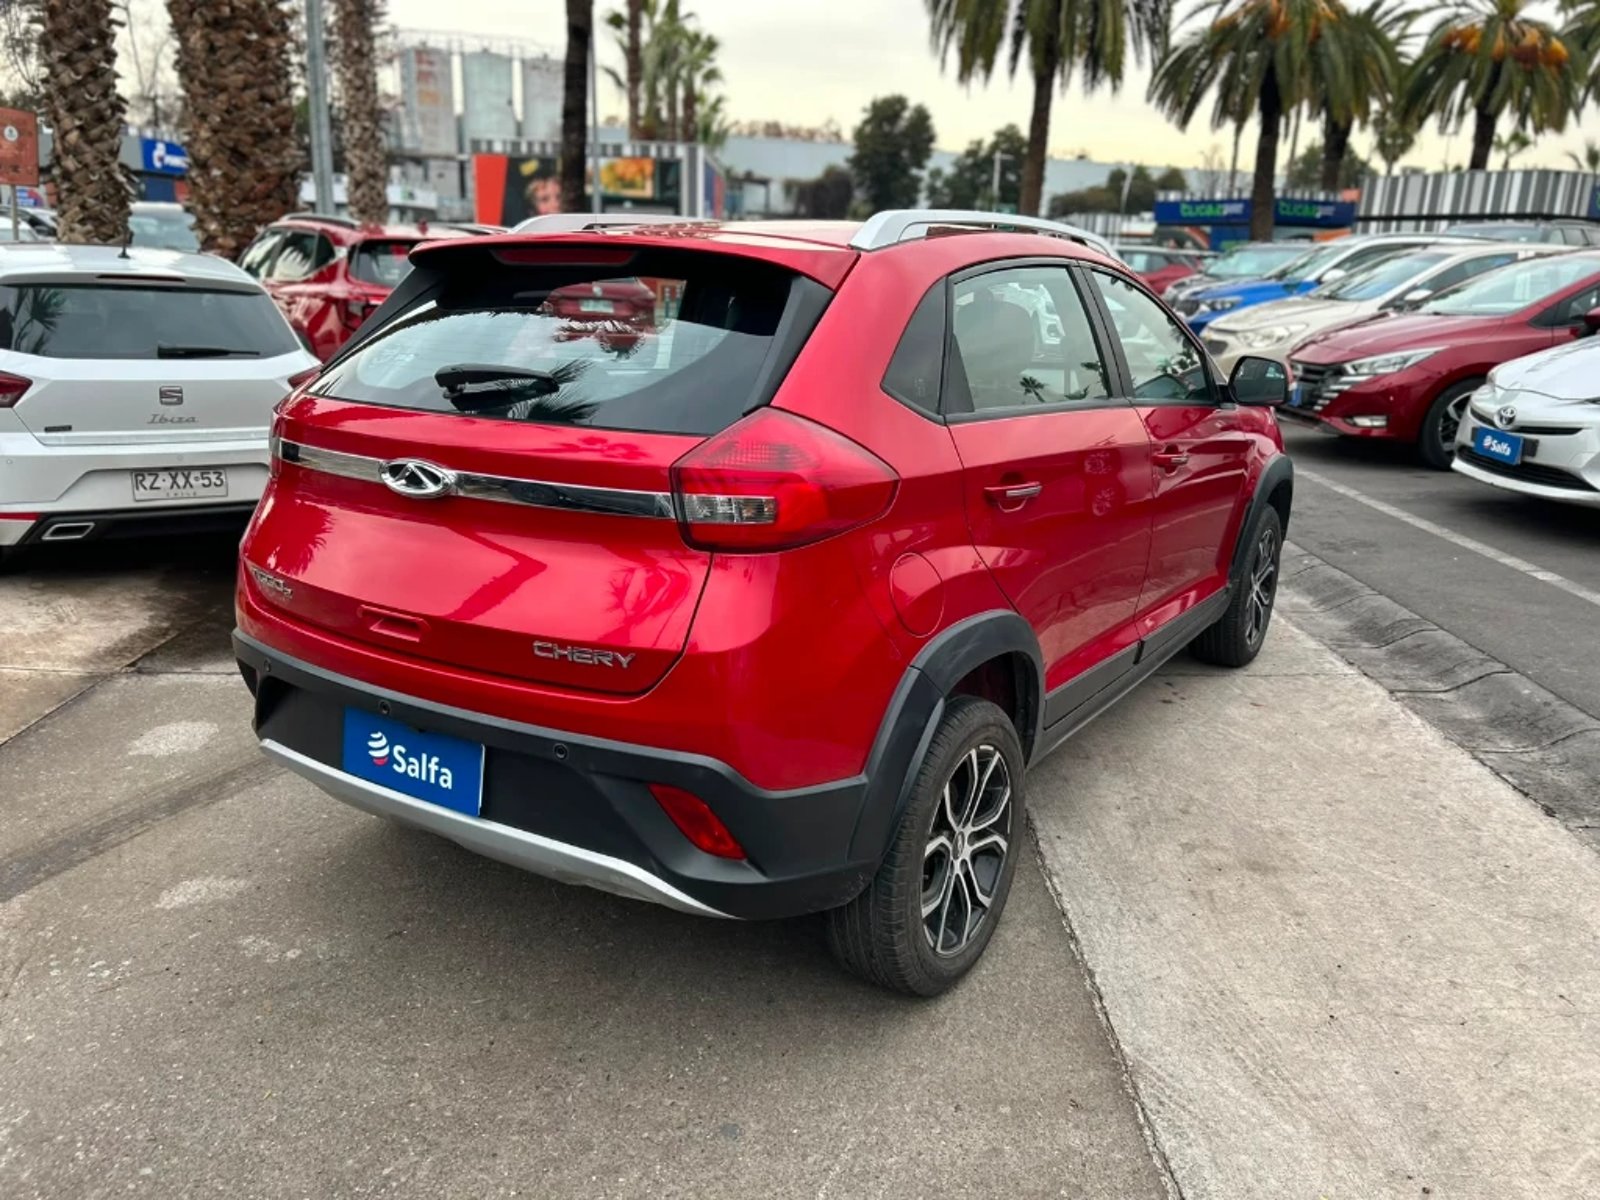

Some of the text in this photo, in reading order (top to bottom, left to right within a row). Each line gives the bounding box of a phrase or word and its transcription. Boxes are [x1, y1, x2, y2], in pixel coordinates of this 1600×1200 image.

[147, 414, 199, 425] Ibiza
[1490, 440, 1511, 455] Salfa
[533, 641, 636, 668] CHERY
[393, 745, 453, 790] Salfa
